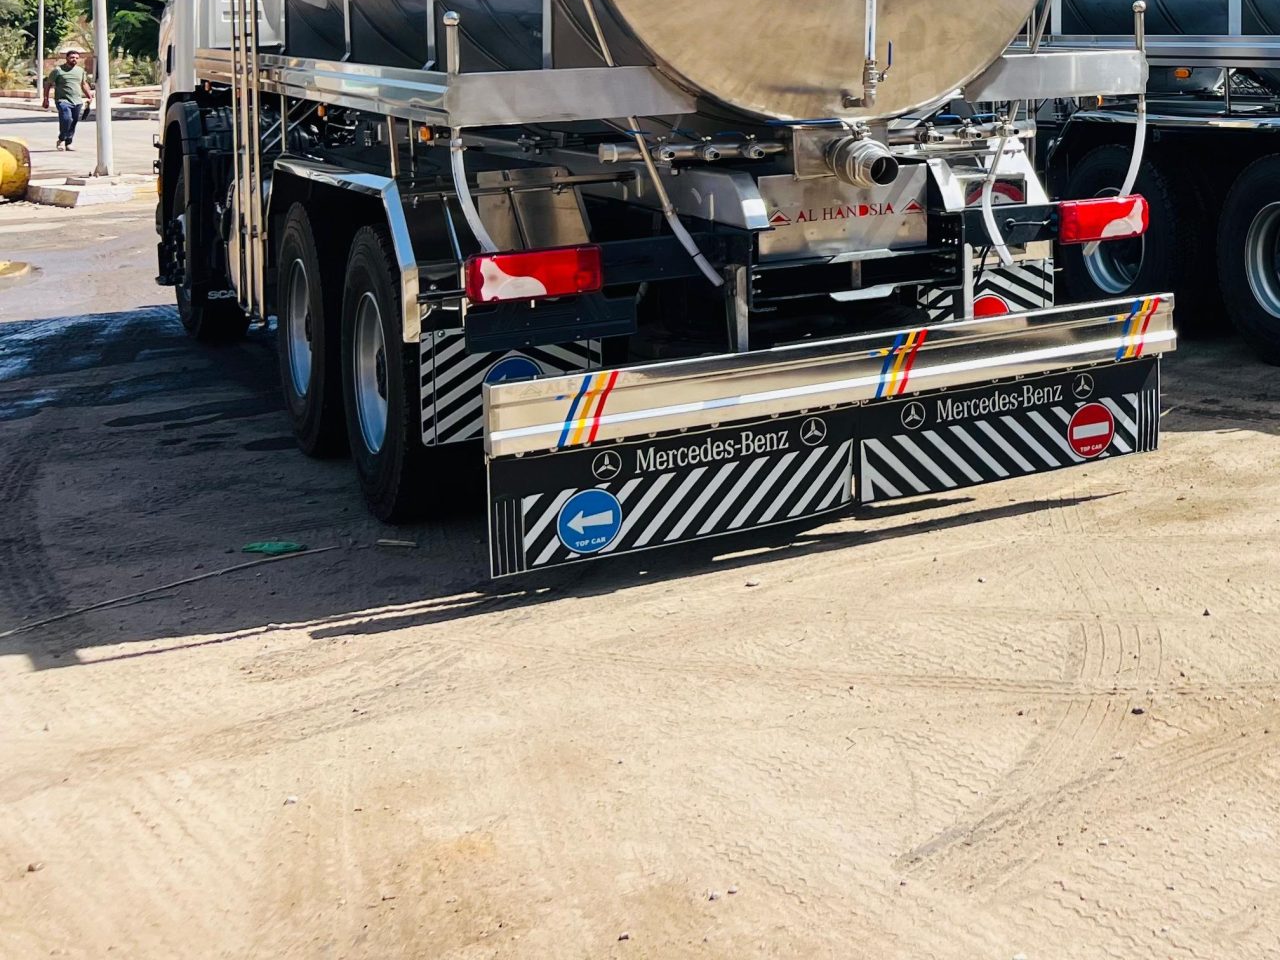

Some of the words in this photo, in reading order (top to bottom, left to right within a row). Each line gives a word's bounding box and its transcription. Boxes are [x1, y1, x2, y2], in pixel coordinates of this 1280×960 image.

[796, 210, 818, 224] AL
[823, 201, 895, 221] HANDSIA
[936, 383, 1063, 423] Mercedes-Benz
[634, 430, 790, 474] Mercedes-Benz
[575, 539, 590, 548] TOP
[591, 536, 606, 545] CAR
